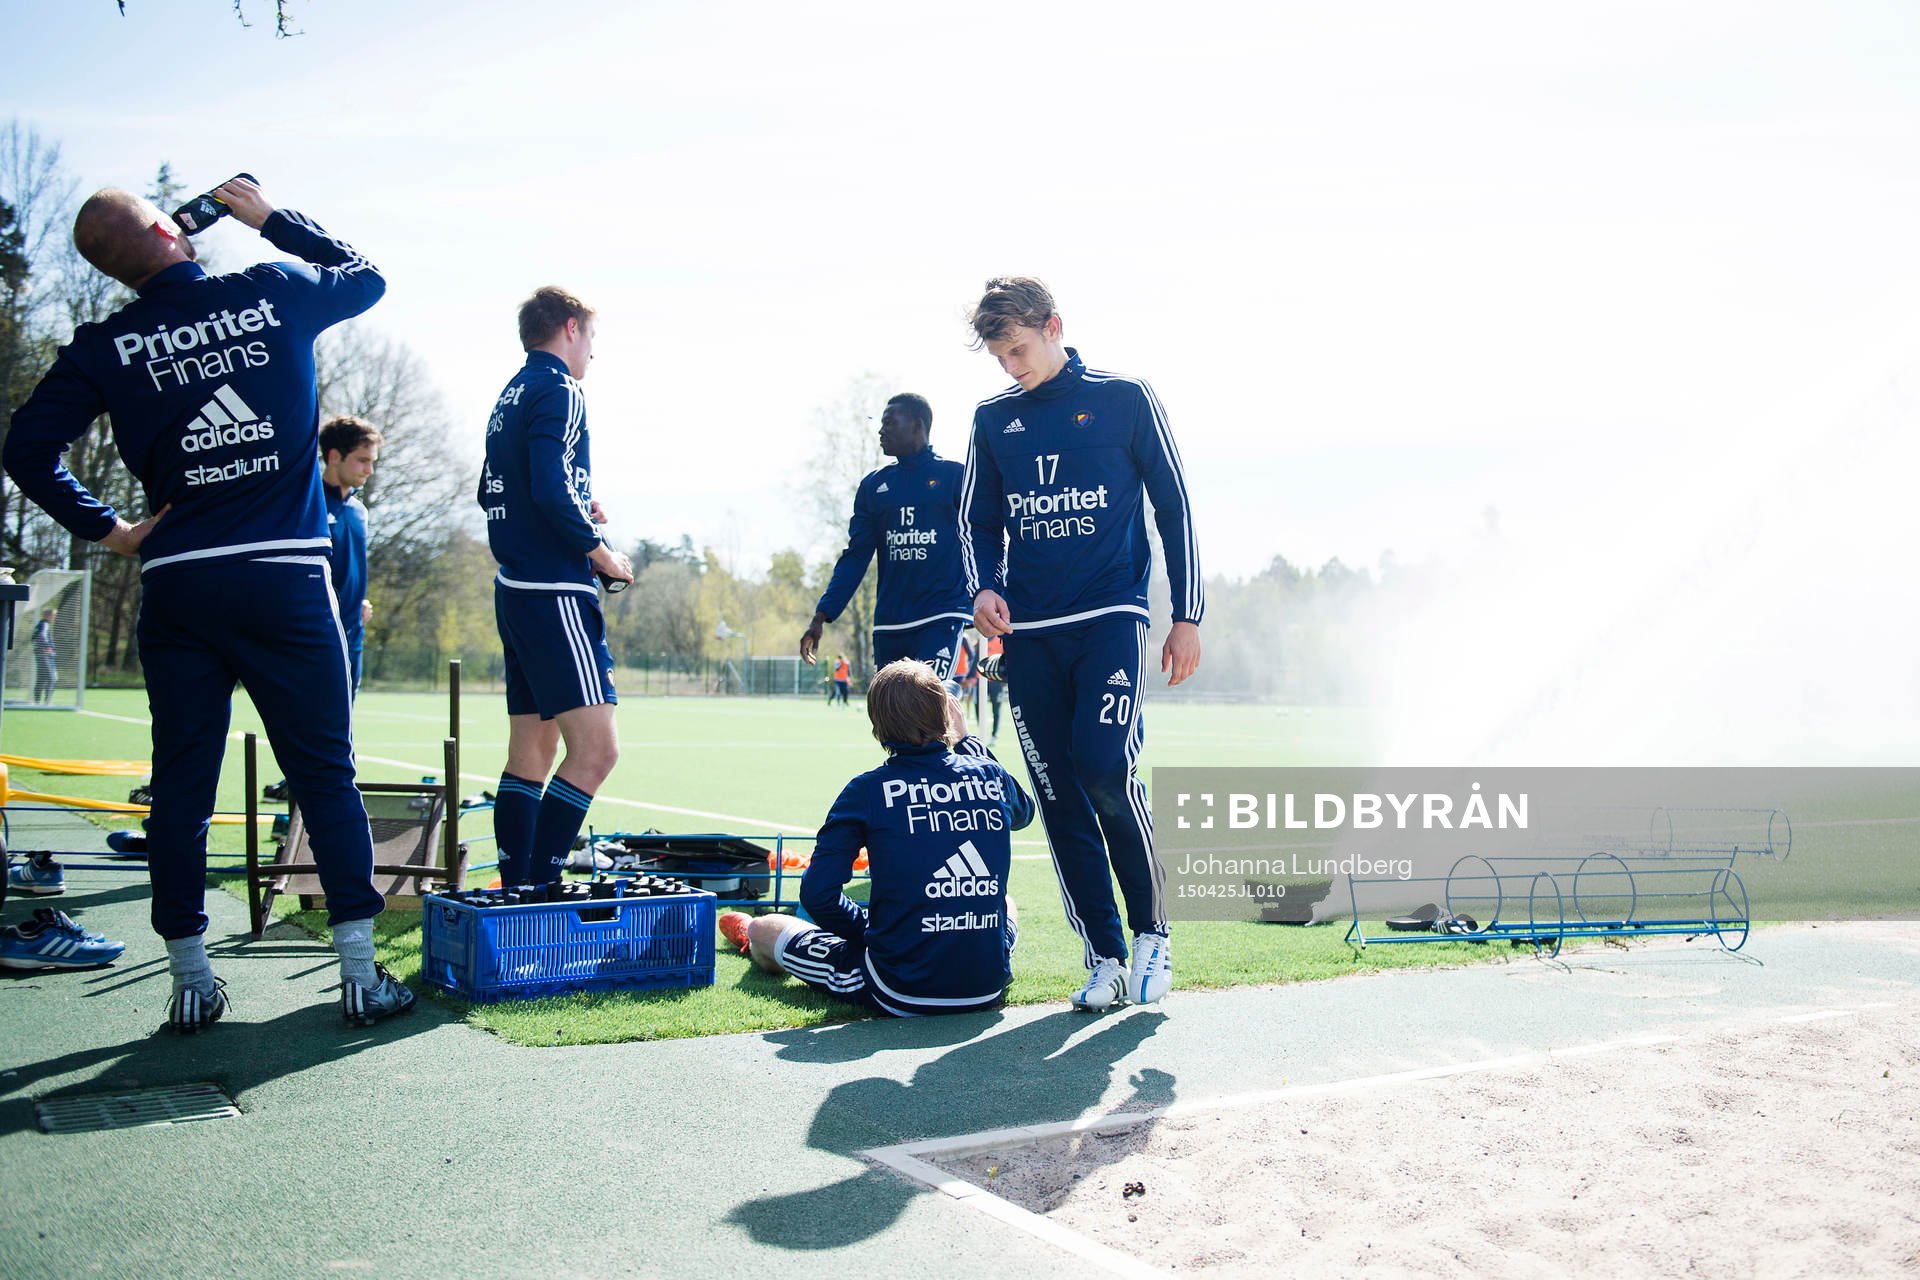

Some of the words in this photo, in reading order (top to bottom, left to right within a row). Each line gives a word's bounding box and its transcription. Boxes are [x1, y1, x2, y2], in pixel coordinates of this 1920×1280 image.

[113, 298, 281, 366] Prioritet
[145, 341, 270, 392] Finans
[181, 418, 275, 453] adidas
[184, 453, 280, 486] stadium
[1034, 454, 1060, 485] 17
[899, 506, 915, 527] 15
[1007, 485, 1108, 518] Prioritet
[886, 528, 937, 546] Prioritet
[1020, 515, 1096, 541] Finans
[934, 658, 950, 680] 15
[1099, 692, 1131, 726] 20
[882, 774, 1007, 809] Prioritet
[906, 804, 1003, 834] Finans
[924, 875, 999, 898] adidas
[921, 911, 999, 932] stadium
